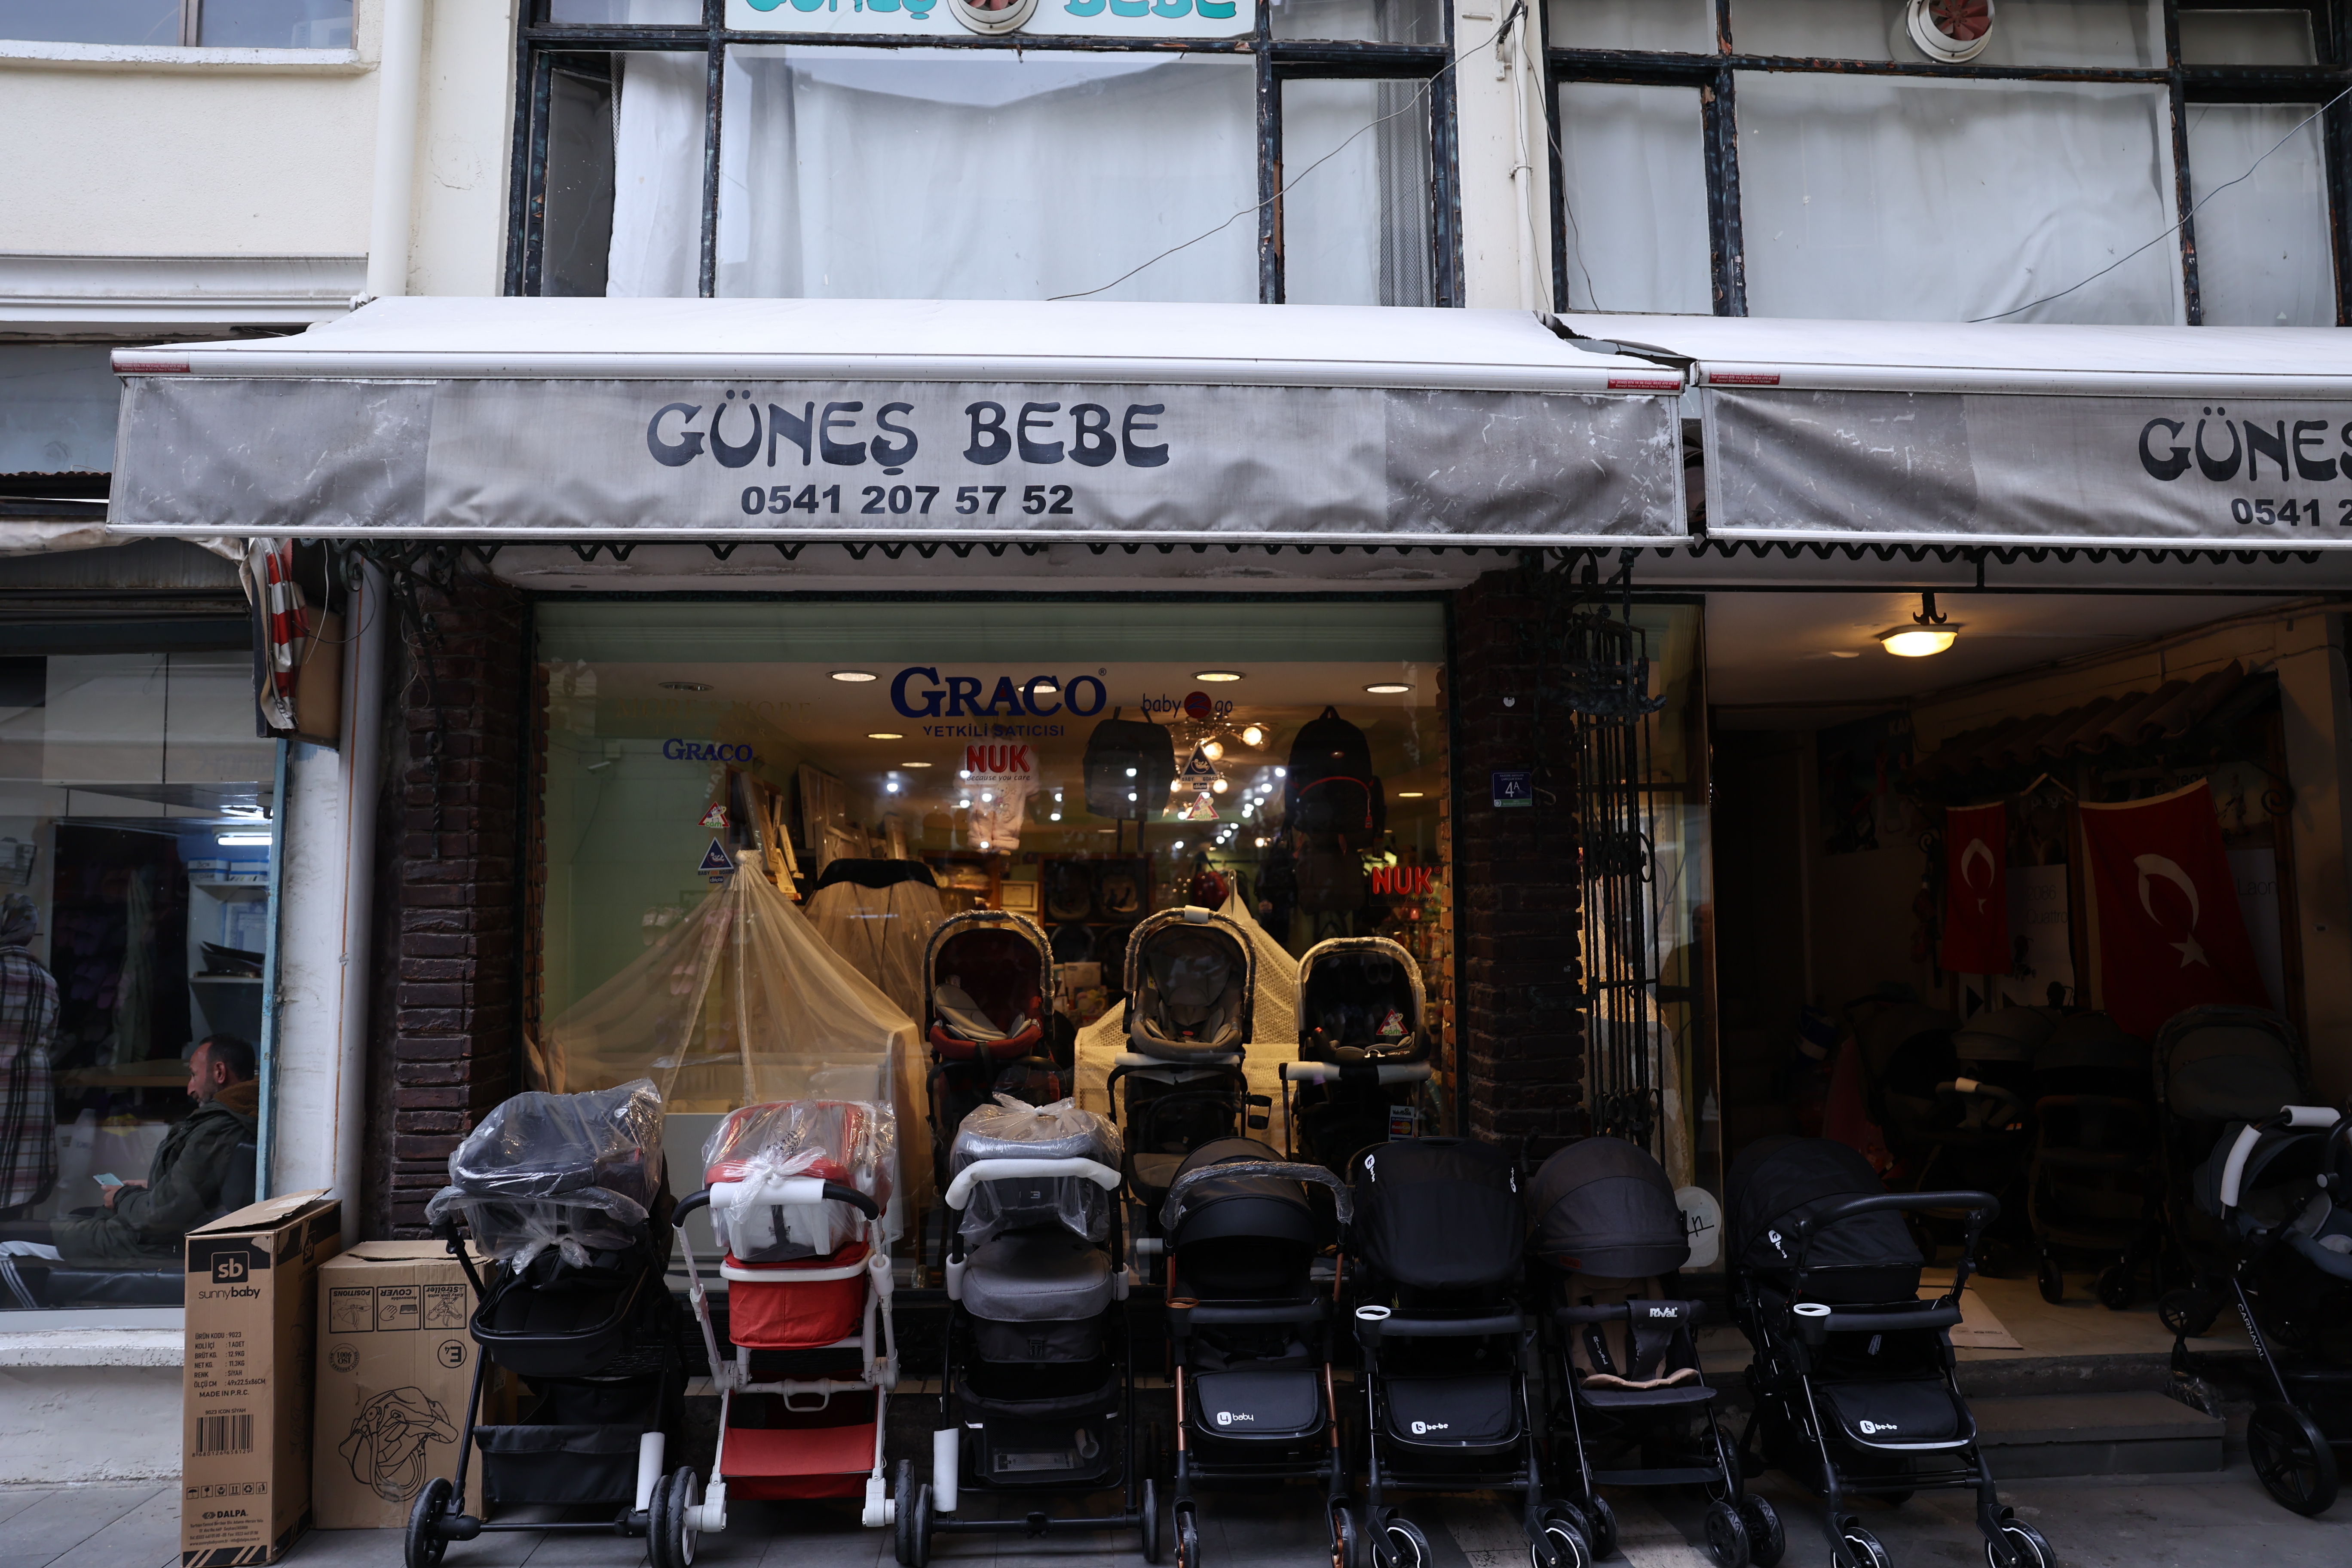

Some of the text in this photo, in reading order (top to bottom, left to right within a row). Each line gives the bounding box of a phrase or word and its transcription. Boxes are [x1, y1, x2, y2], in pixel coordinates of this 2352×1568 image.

[647, 389, 1170, 475] GÜNEŞ BEBE
[2139, 407, 2352, 481] GÜNE
[741, 484, 1073, 514] 0541 207 57 52
[2231, 498, 2320, 526] 0541
[891, 667, 1107, 718] GRACO
[1143, 693, 1181, 718] baby
[1215, 700, 1233, 718] go
[923, 723, 1064, 737] YETKİLİ SATICISI
[663, 738, 753, 762] GRACO
[967, 745, 1029, 772] NUK
[1372, 866, 1433, 894] NUK
[2027, 885, 2057, 901] 2086
[2026, 908, 2068, 925] Quattro
[218, 1258, 243, 1278] sb
[199, 1286, 260, 1300] sunnybaby
[2238, 1304, 2264, 1361] CARNAVAL
[194, 1381, 208, 1389] ÖLÇÜ
[1232, 1413, 1254, 1421] baby
[217, 1510, 246, 1518] DALPA
